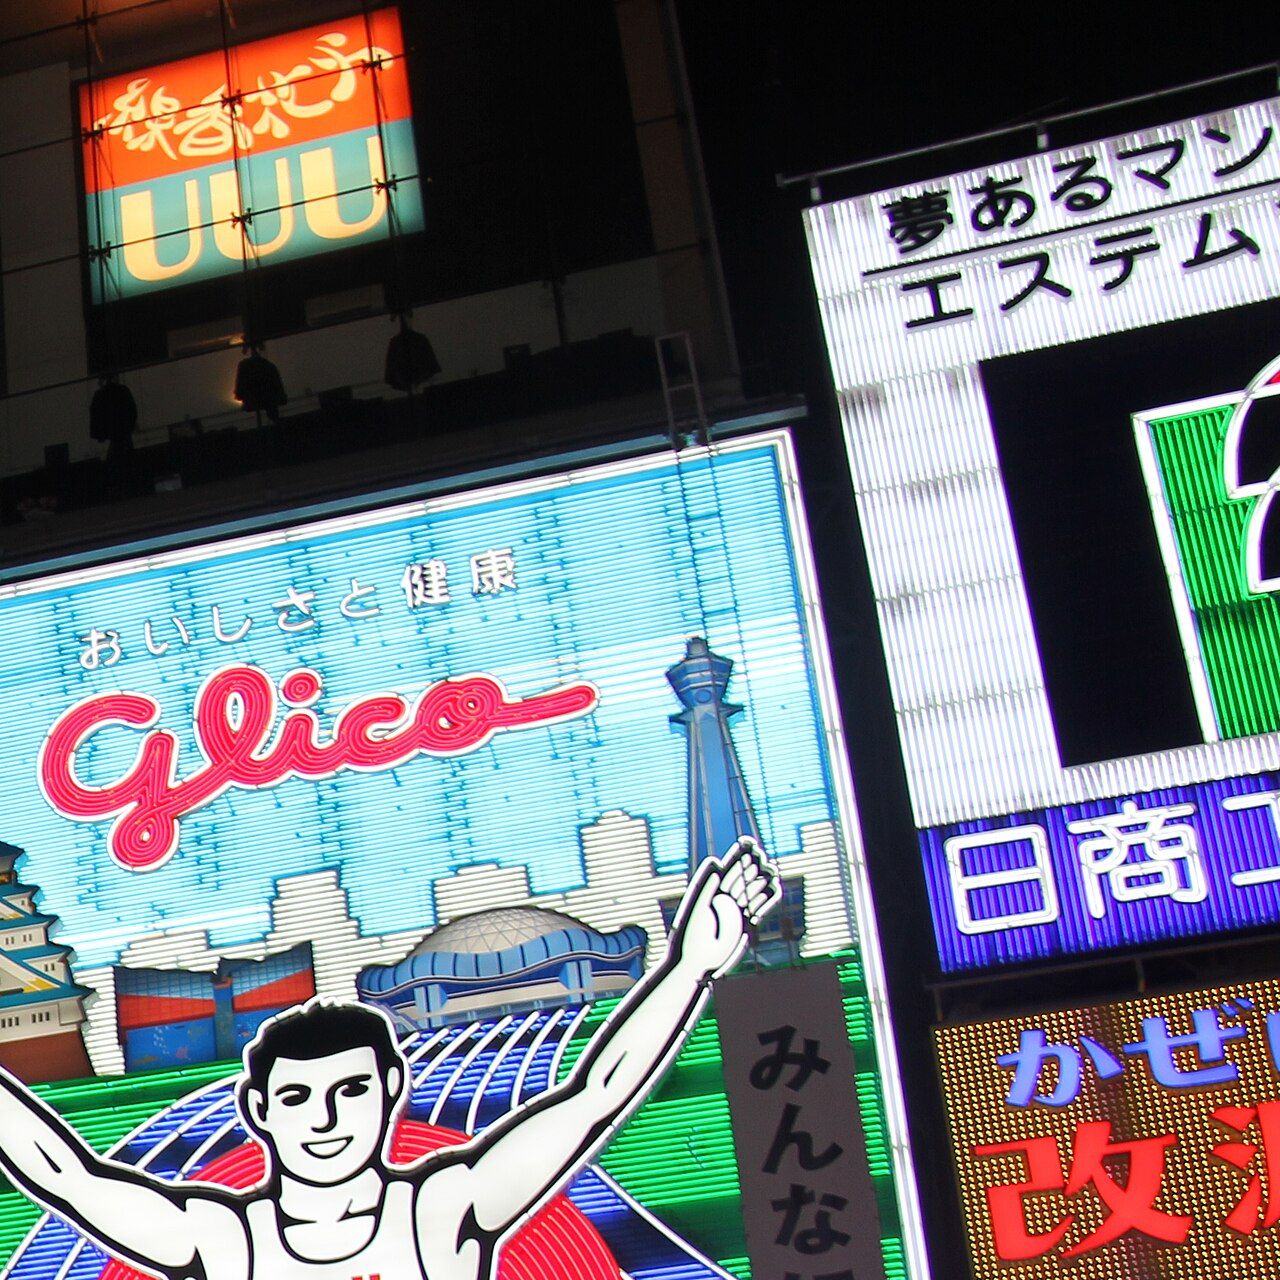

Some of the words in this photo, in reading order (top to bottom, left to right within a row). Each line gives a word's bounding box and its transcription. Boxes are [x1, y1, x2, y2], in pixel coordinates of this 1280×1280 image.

[119, 136, 388, 283] UUU
[900, 213, 1261, 329] エステム
[79, 547, 518, 669] おいしさと健康
[38, 664, 599, 870] Glico
